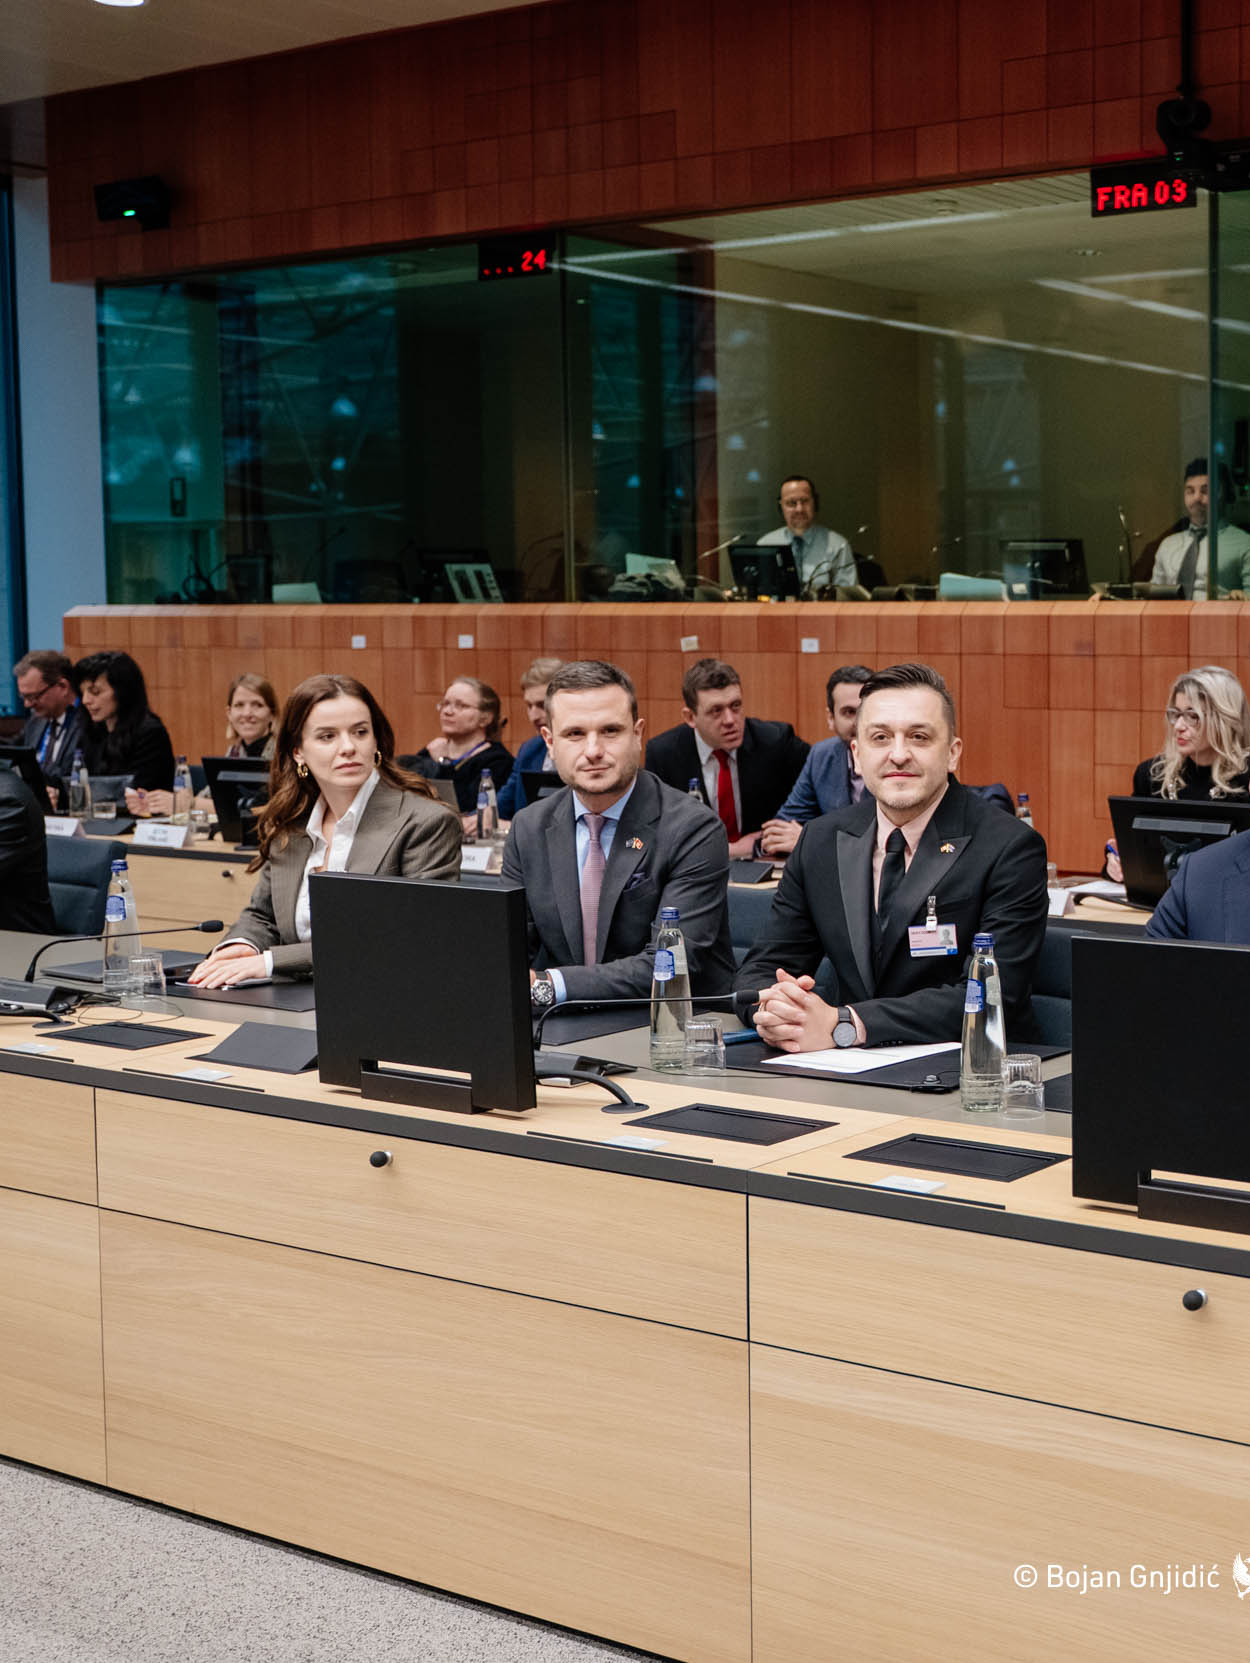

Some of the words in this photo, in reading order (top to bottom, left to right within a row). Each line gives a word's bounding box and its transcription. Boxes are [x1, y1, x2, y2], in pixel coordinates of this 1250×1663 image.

[1096, 182, 1149, 212] FRA
[1153, 178, 1188, 205] 03
[520, 249, 547, 272] 24
